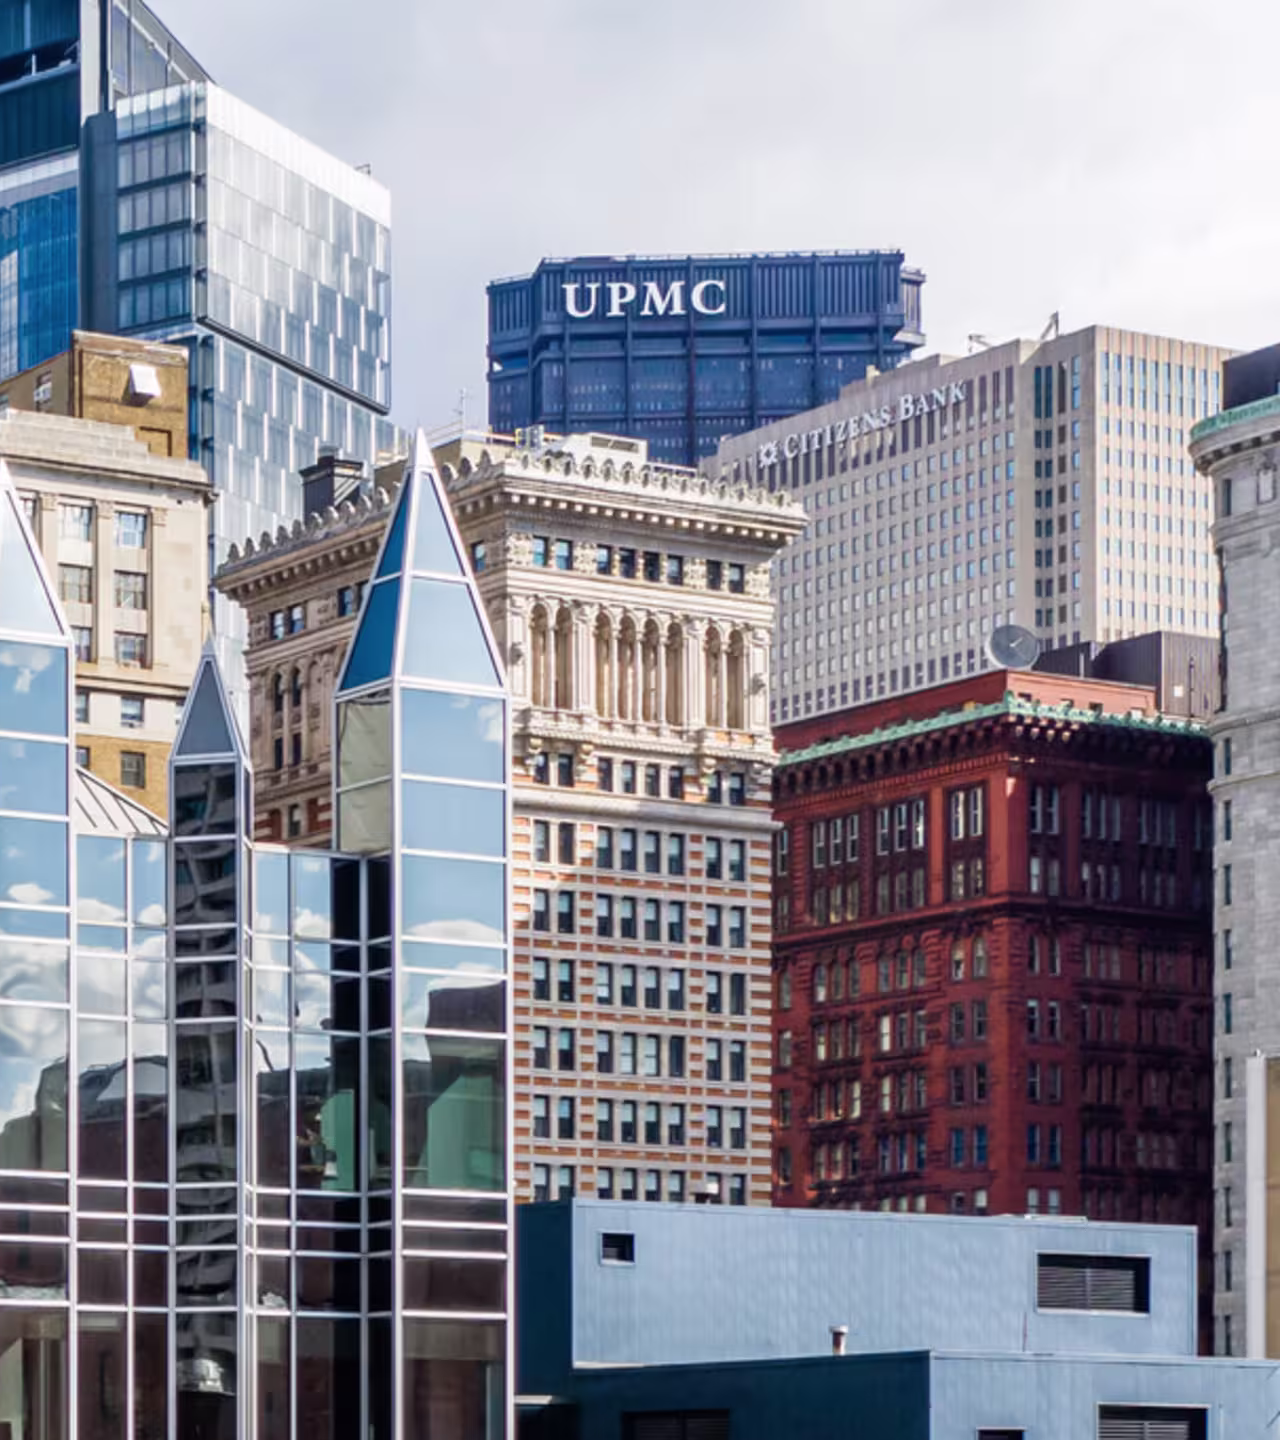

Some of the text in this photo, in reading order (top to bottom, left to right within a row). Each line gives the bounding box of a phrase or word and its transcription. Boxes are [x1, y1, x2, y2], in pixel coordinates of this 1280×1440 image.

[561, 279, 726, 318] UPMC
[783, 381, 966, 459] CITIZENS BANK
